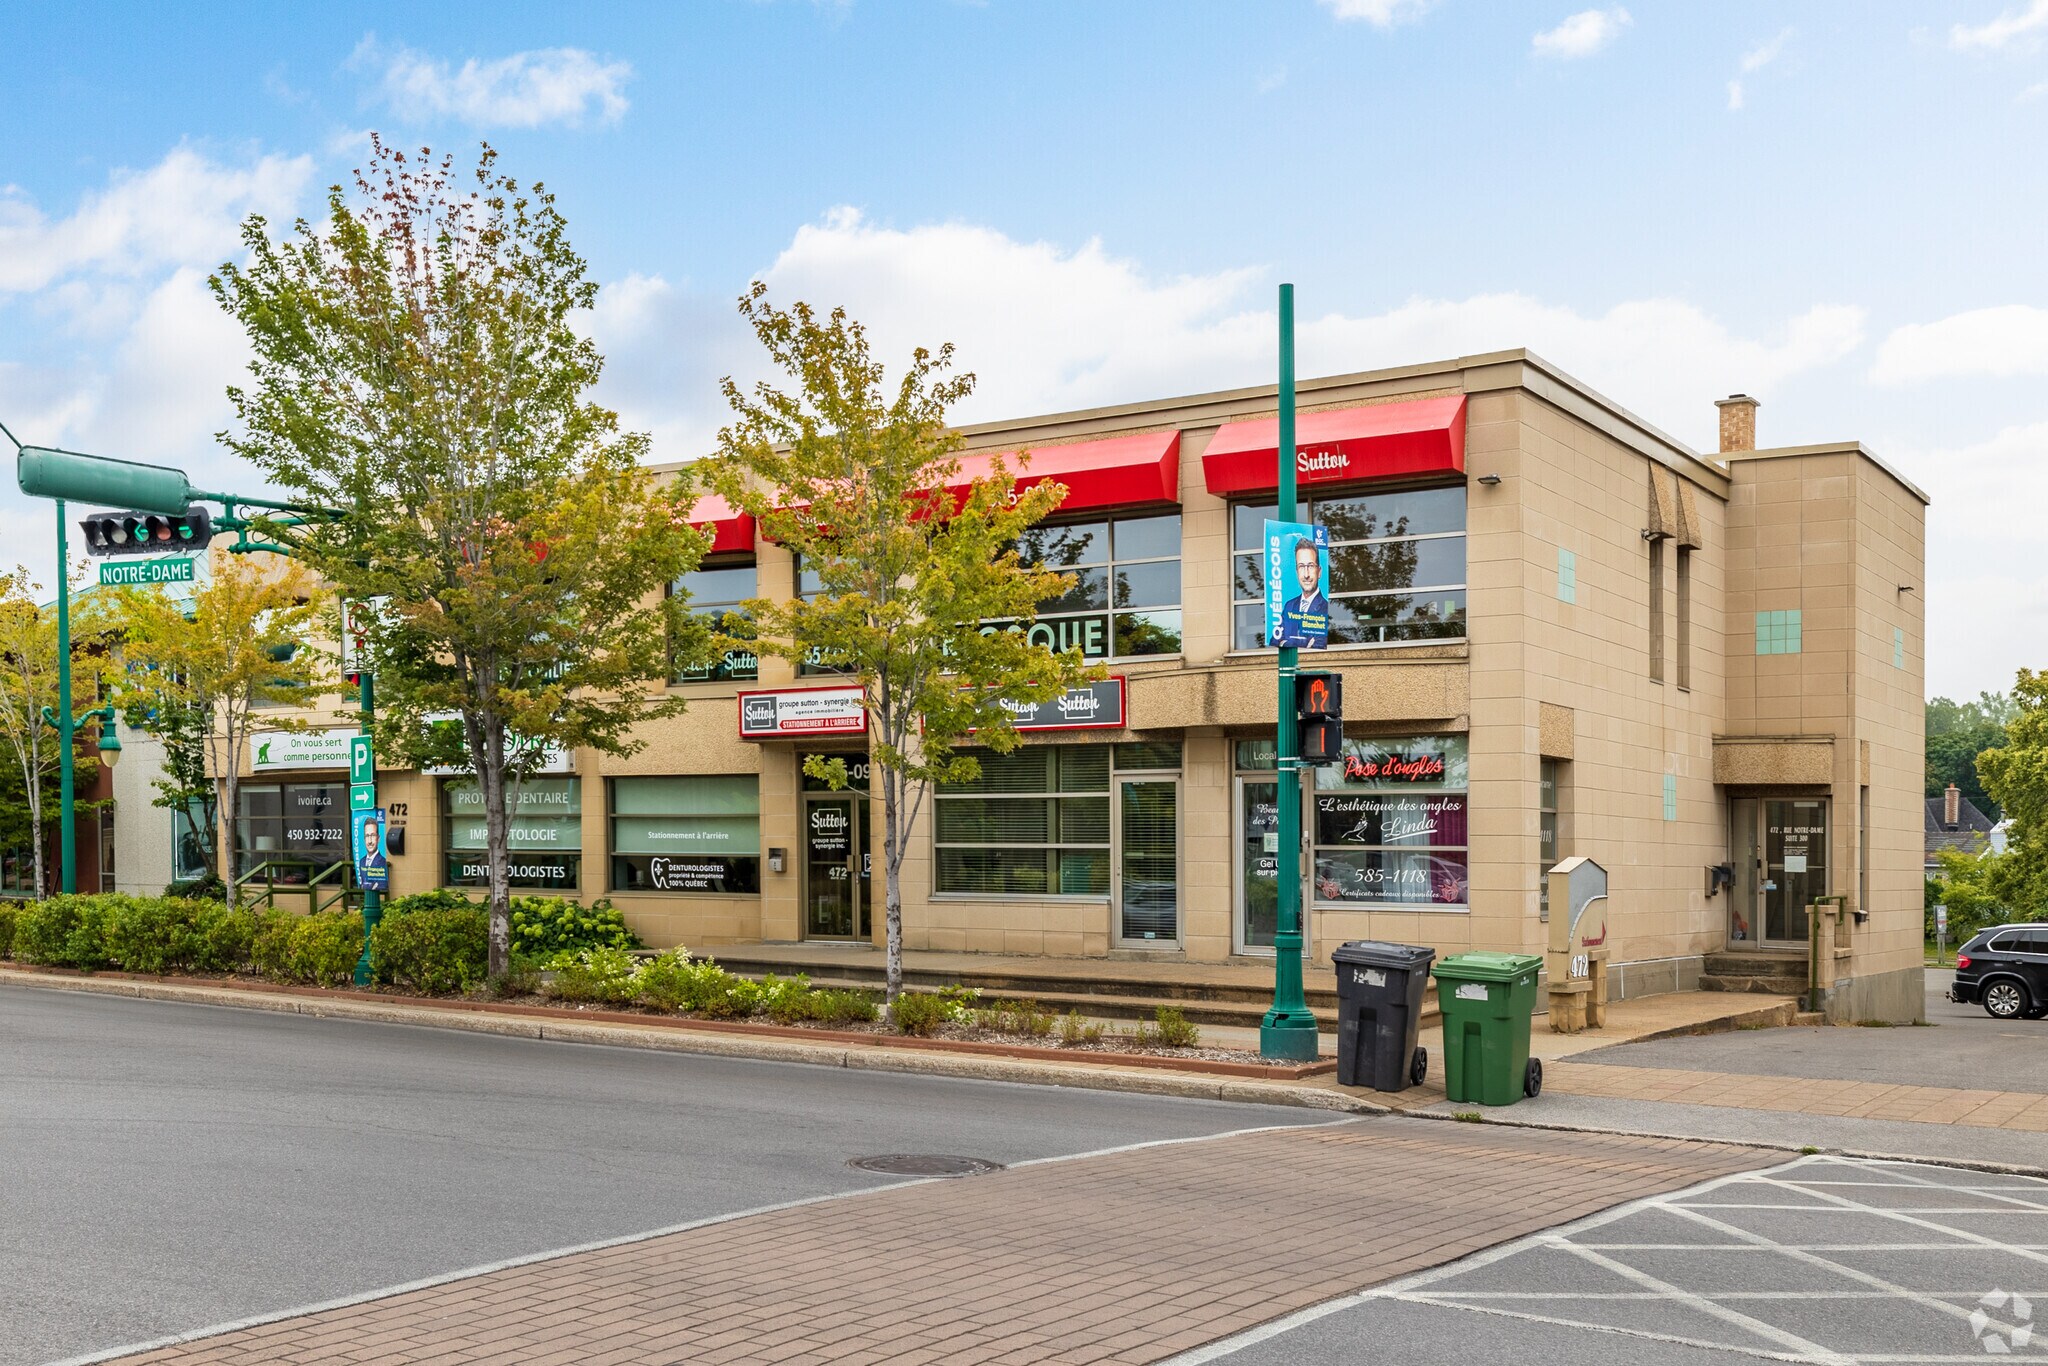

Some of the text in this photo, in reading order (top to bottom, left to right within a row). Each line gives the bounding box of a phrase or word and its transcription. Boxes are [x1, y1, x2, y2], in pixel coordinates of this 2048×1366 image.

[1297, 452, 1350, 472] Sutton
[103, 563, 190, 584] NOTRE-DAME
[1269, 536, 1284, 640] QUÉBÉCOIS
[779, 700, 799, 709] groupe
[824, 697, 849, 707] synergie
[1058, 695, 1100, 712] Sutton
[745, 705, 776, 721] Sutton
[783, 719, 824, 728] STATIONNEMENT
[291, 739, 342, 748] On vous sert
[283, 754, 310, 762] comme
[355, 743, 367, 777] P
[1253, 751, 1277, 760] Local
[1344, 755, 1443, 781] Pose d'ongles
[298, 795, 332, 805] ivoire.ca
[517, 792, 569, 804] DENTAIRE
[389, 803, 408, 816] 472
[1319, 797, 1462, 815] L'esthétique des ongles
[811, 812, 848, 828] Sutton
[1252, 816, 1266, 825] des
[1381, 813, 1438, 838] Linda
[287, 829, 343, 840] 450 932-7222
[648, 831, 729, 839] Stationnement à l'arrière
[1794, 826, 1824, 834] NOTRE-DAME
[668, 864, 724, 872] DENTUROLOGISTES
[1260, 860, 1274, 868] Gel
[829, 867, 848, 877] 472
[1354, 868, 1427, 883] 585-1118
[685, 879, 708, 888] QUÉBEC
[1339, 888, 1440, 900] Certificats cadeaux disponibles
[1571, 954, 1588, 977] 472
